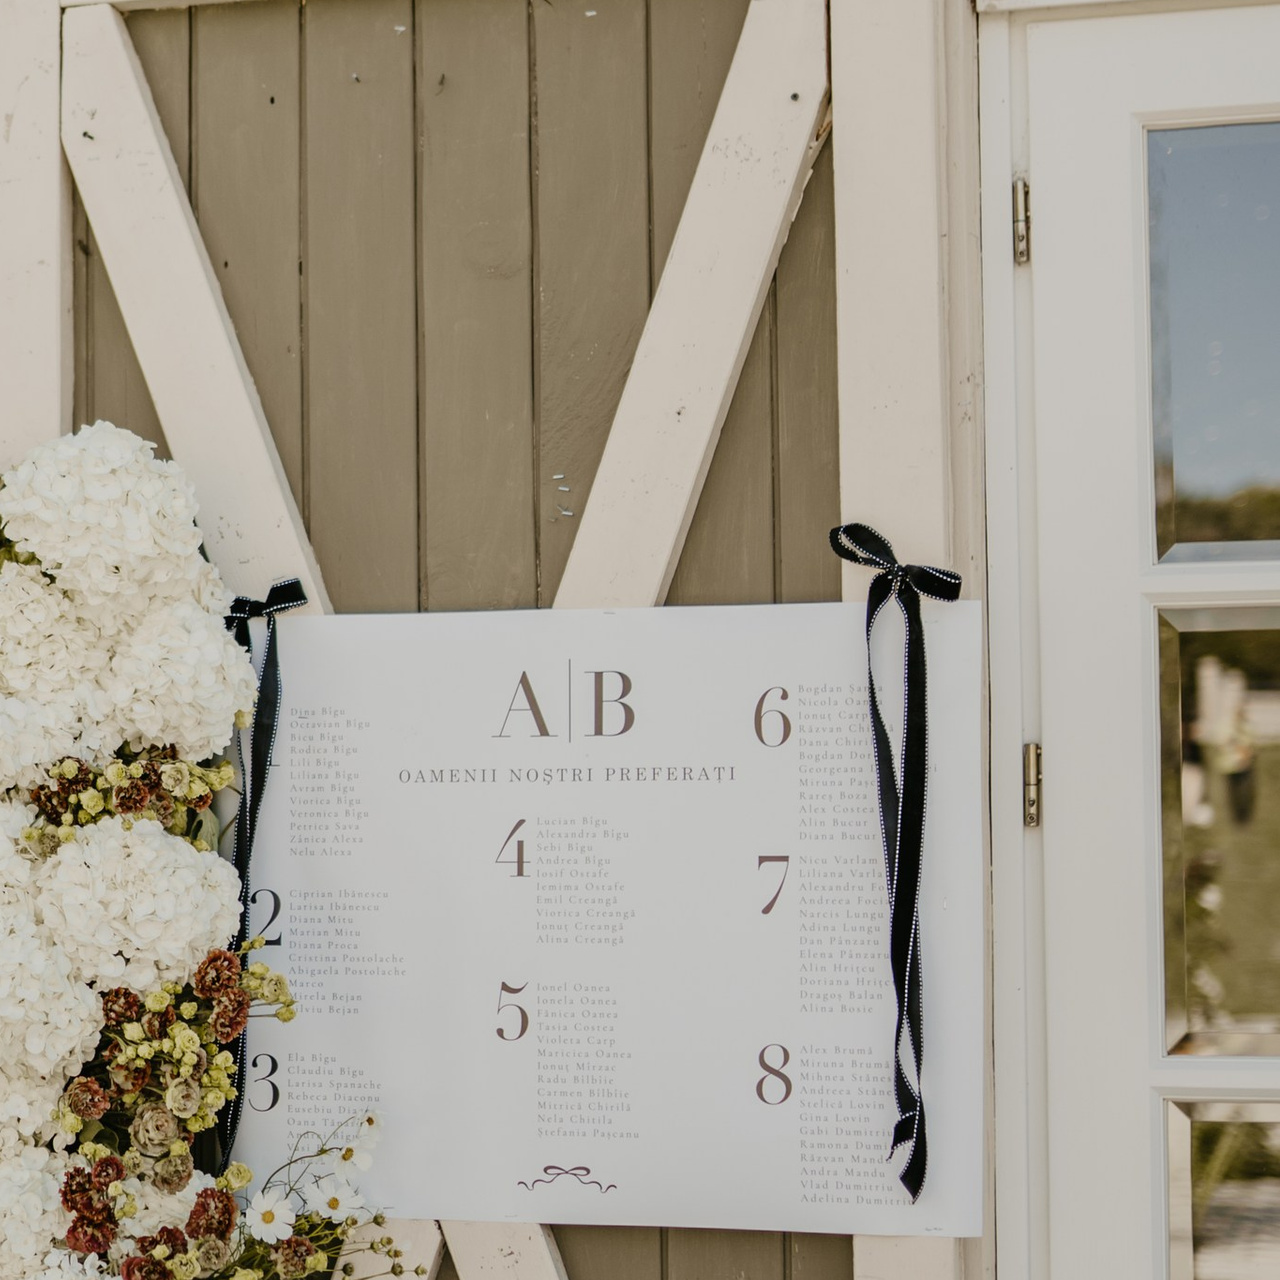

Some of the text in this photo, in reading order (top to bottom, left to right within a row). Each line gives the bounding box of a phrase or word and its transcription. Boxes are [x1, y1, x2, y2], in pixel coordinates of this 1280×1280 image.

[754, 686, 792, 747] 6
[399, 769, 498, 783] OAMENII
[495, 819, 531, 877] 4
[757, 855, 790, 915] 7
[250, 889, 282, 946] 2
[496, 981, 529, 1041] 5
[248, 1053, 280, 1112] 3
[755, 1043, 792, 1105] 8
